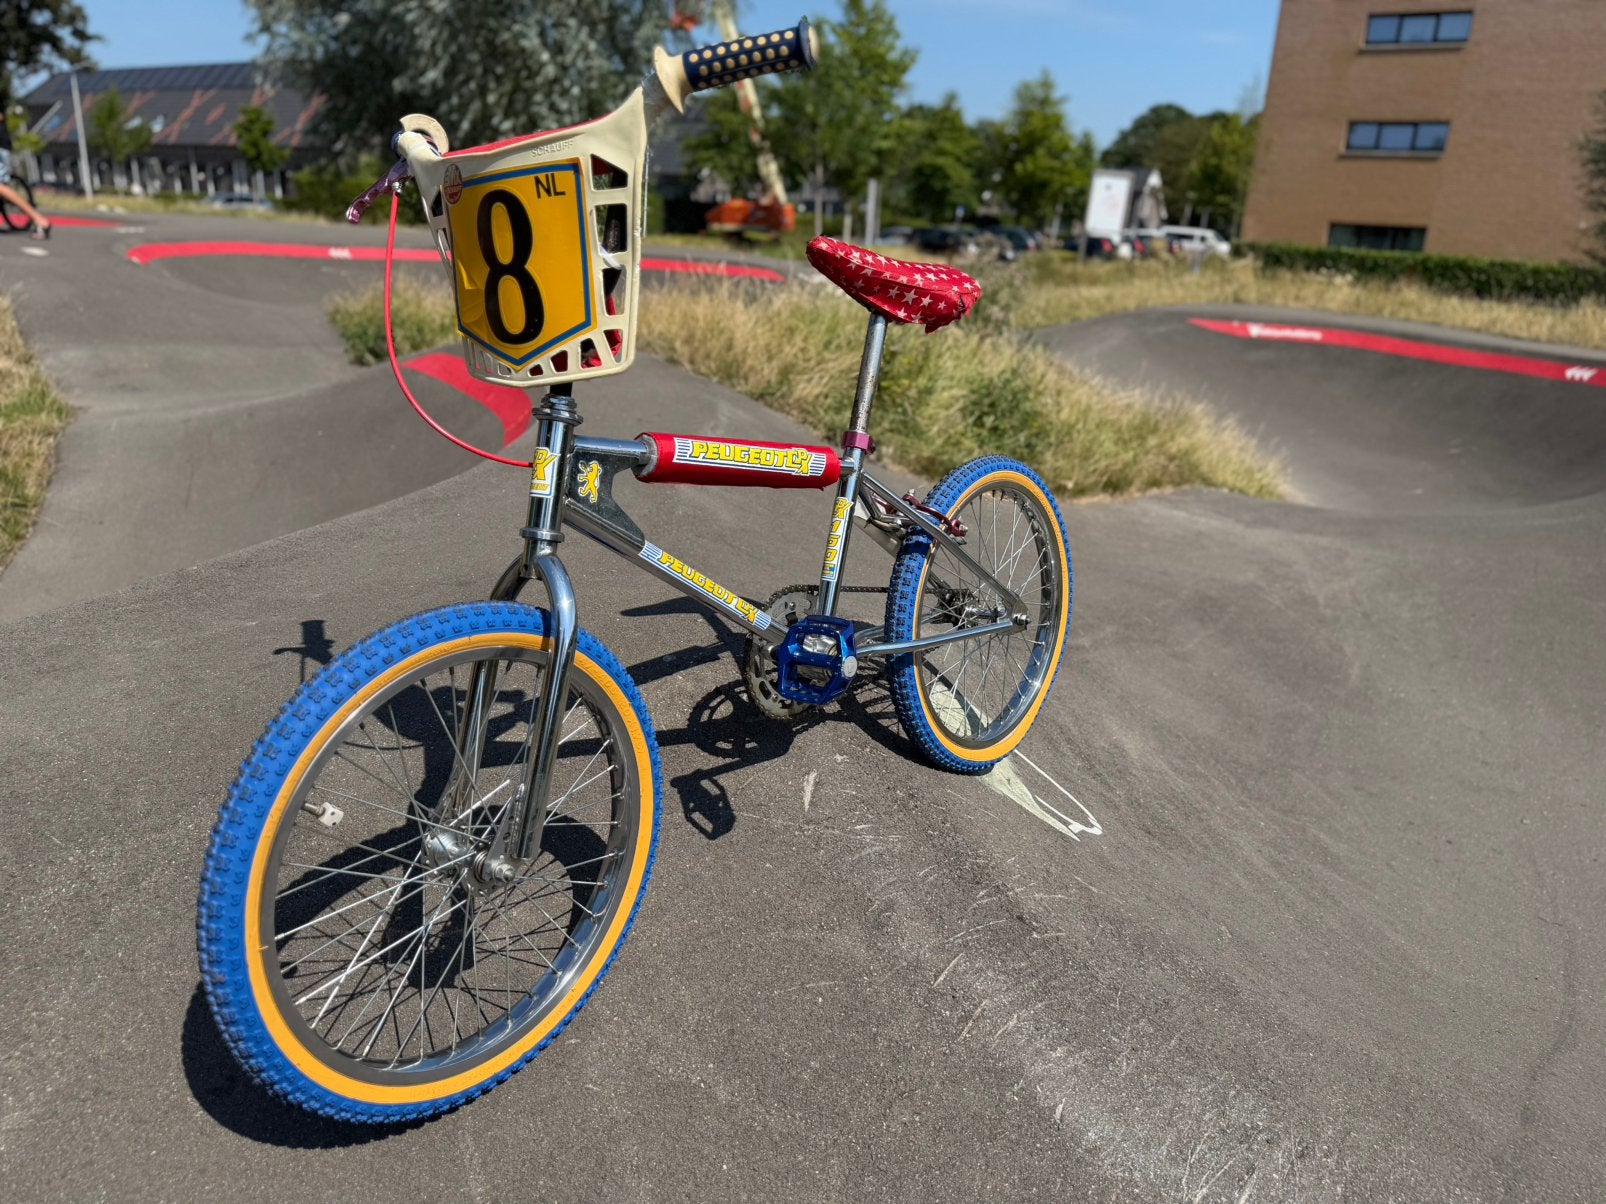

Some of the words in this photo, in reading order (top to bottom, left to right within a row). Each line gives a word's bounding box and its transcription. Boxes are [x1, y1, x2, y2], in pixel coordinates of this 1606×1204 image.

[531, 140, 574, 158] SCHAUFF
[533, 172, 566, 199] NL
[476, 188, 546, 346] 8
[691, 440, 788, 468] PEUGEOT
[659, 551, 738, 605] PEUGEOT
